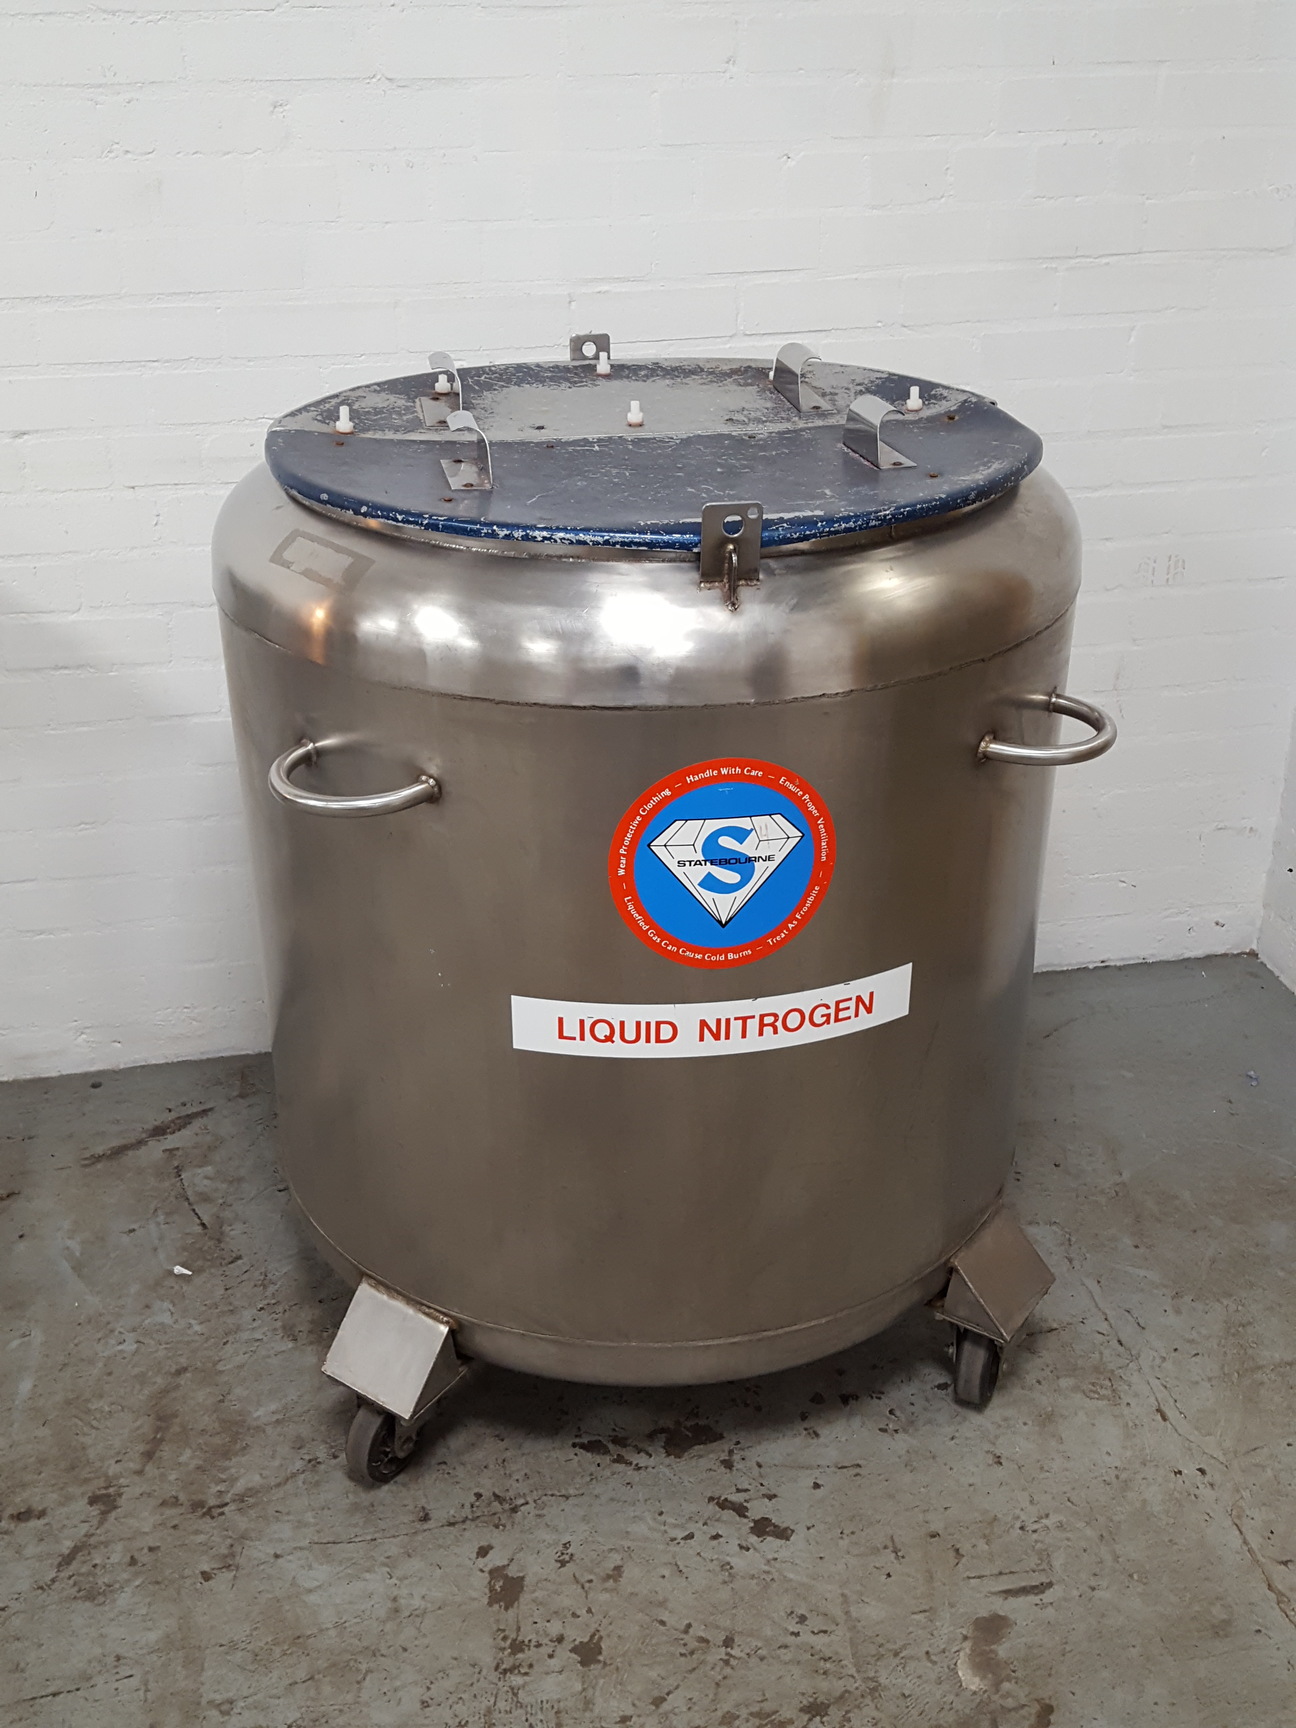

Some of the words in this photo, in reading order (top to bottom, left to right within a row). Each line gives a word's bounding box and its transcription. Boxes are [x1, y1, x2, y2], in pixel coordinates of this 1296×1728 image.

[686, 769, 718, 784] Handle
[720, 766, 742, 775] With
[744, 767, 763, 777] Care
[639, 788, 672, 816] Clothing
[779, 776, 803, 797] Ensure
[802, 794, 819, 817] Proper
[817, 817, 828, 862] Ventilation
[619, 816, 642, 854] Protective
[617, 856, 627, 876] Wear
[677, 854, 775, 868] STATEBOURNE
[623, 896, 649, 931] Liquefied
[647, 929, 661, 943] Gas
[661, 940, 677, 952] Can
[679, 947, 703, 959] Cause
[704, 953, 725, 961] Cold
[727, 949, 752, 960] Burns
[766, 929, 788, 946] Treat
[787, 920, 798, 930] As
[795, 885, 820, 919] Frostbite
[557, 1016, 679, 1044] LIQUID
[699, 991, 875, 1043] NITROGEN
